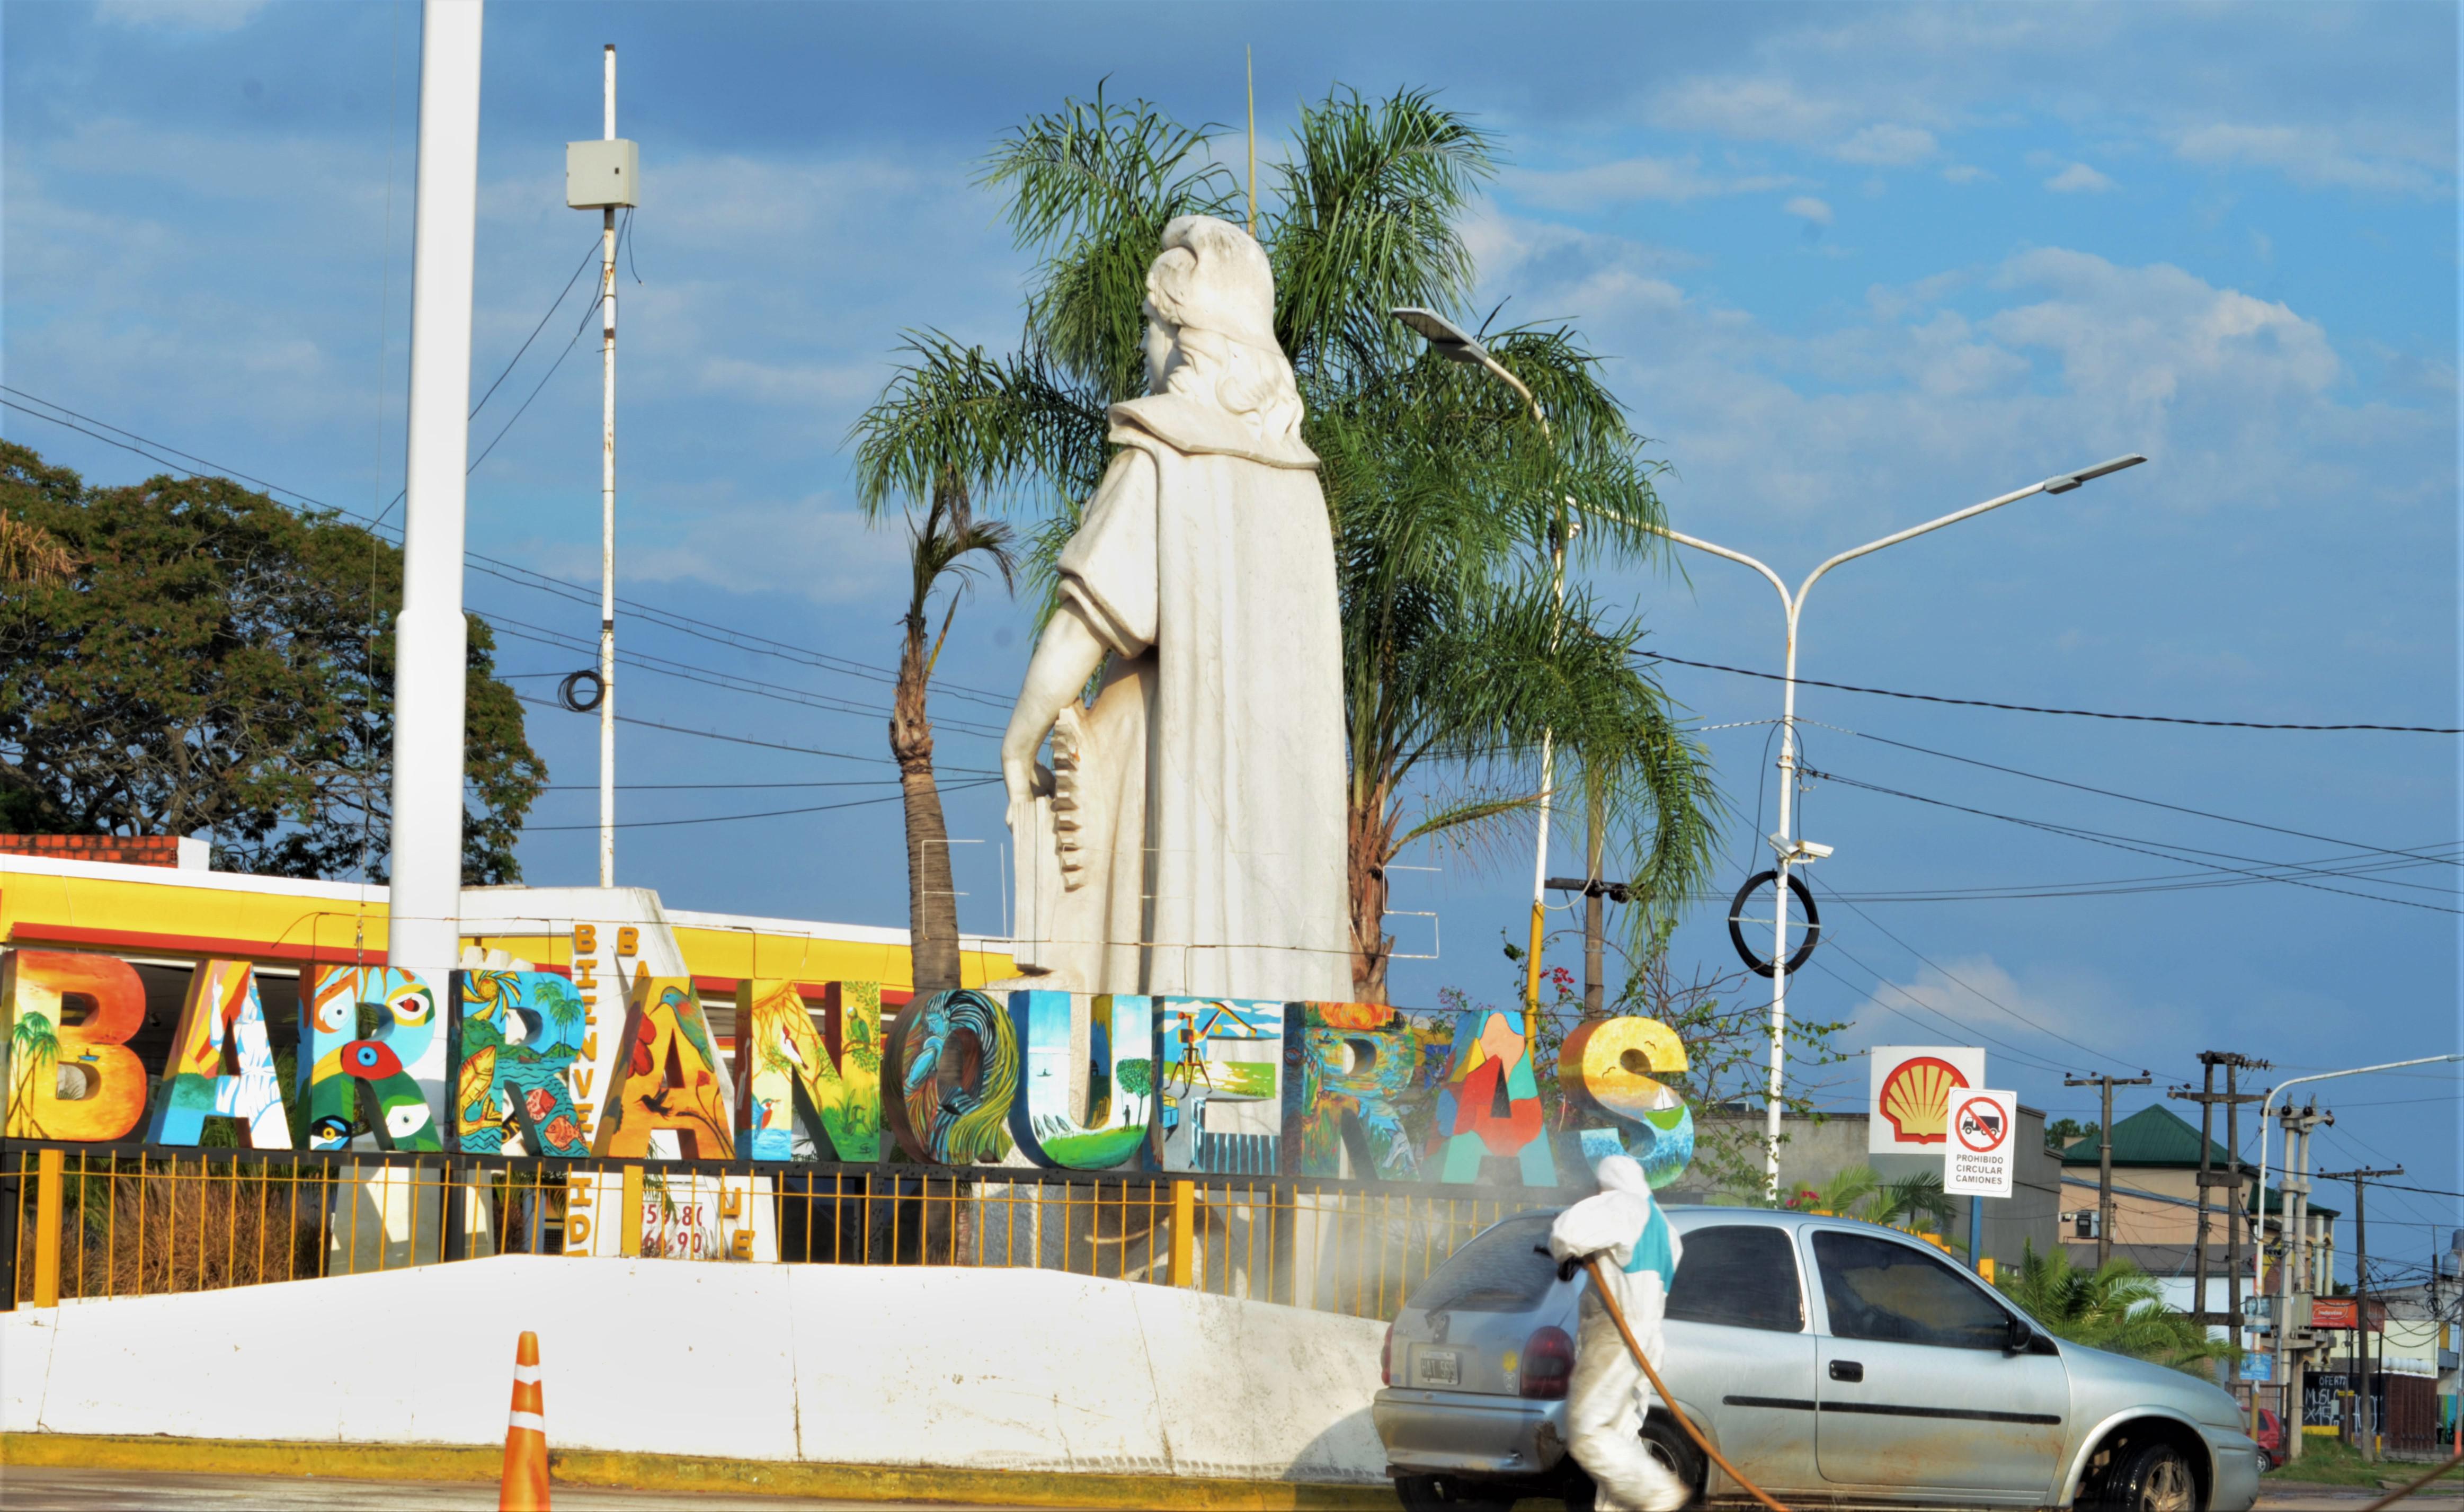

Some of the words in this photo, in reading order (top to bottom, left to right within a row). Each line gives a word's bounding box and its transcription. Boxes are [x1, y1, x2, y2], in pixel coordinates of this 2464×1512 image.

[3, 949, 1694, 1189] BARRANQUERAS
[1956, 1154, 2003, 1164] PROHIBIDO
[1956, 1164, 2003, 1175] CIRCULAR
[1956, 1175, 2002, 1185] CAMIONES
[2306, 1388, 2339, 1406] MUSL
